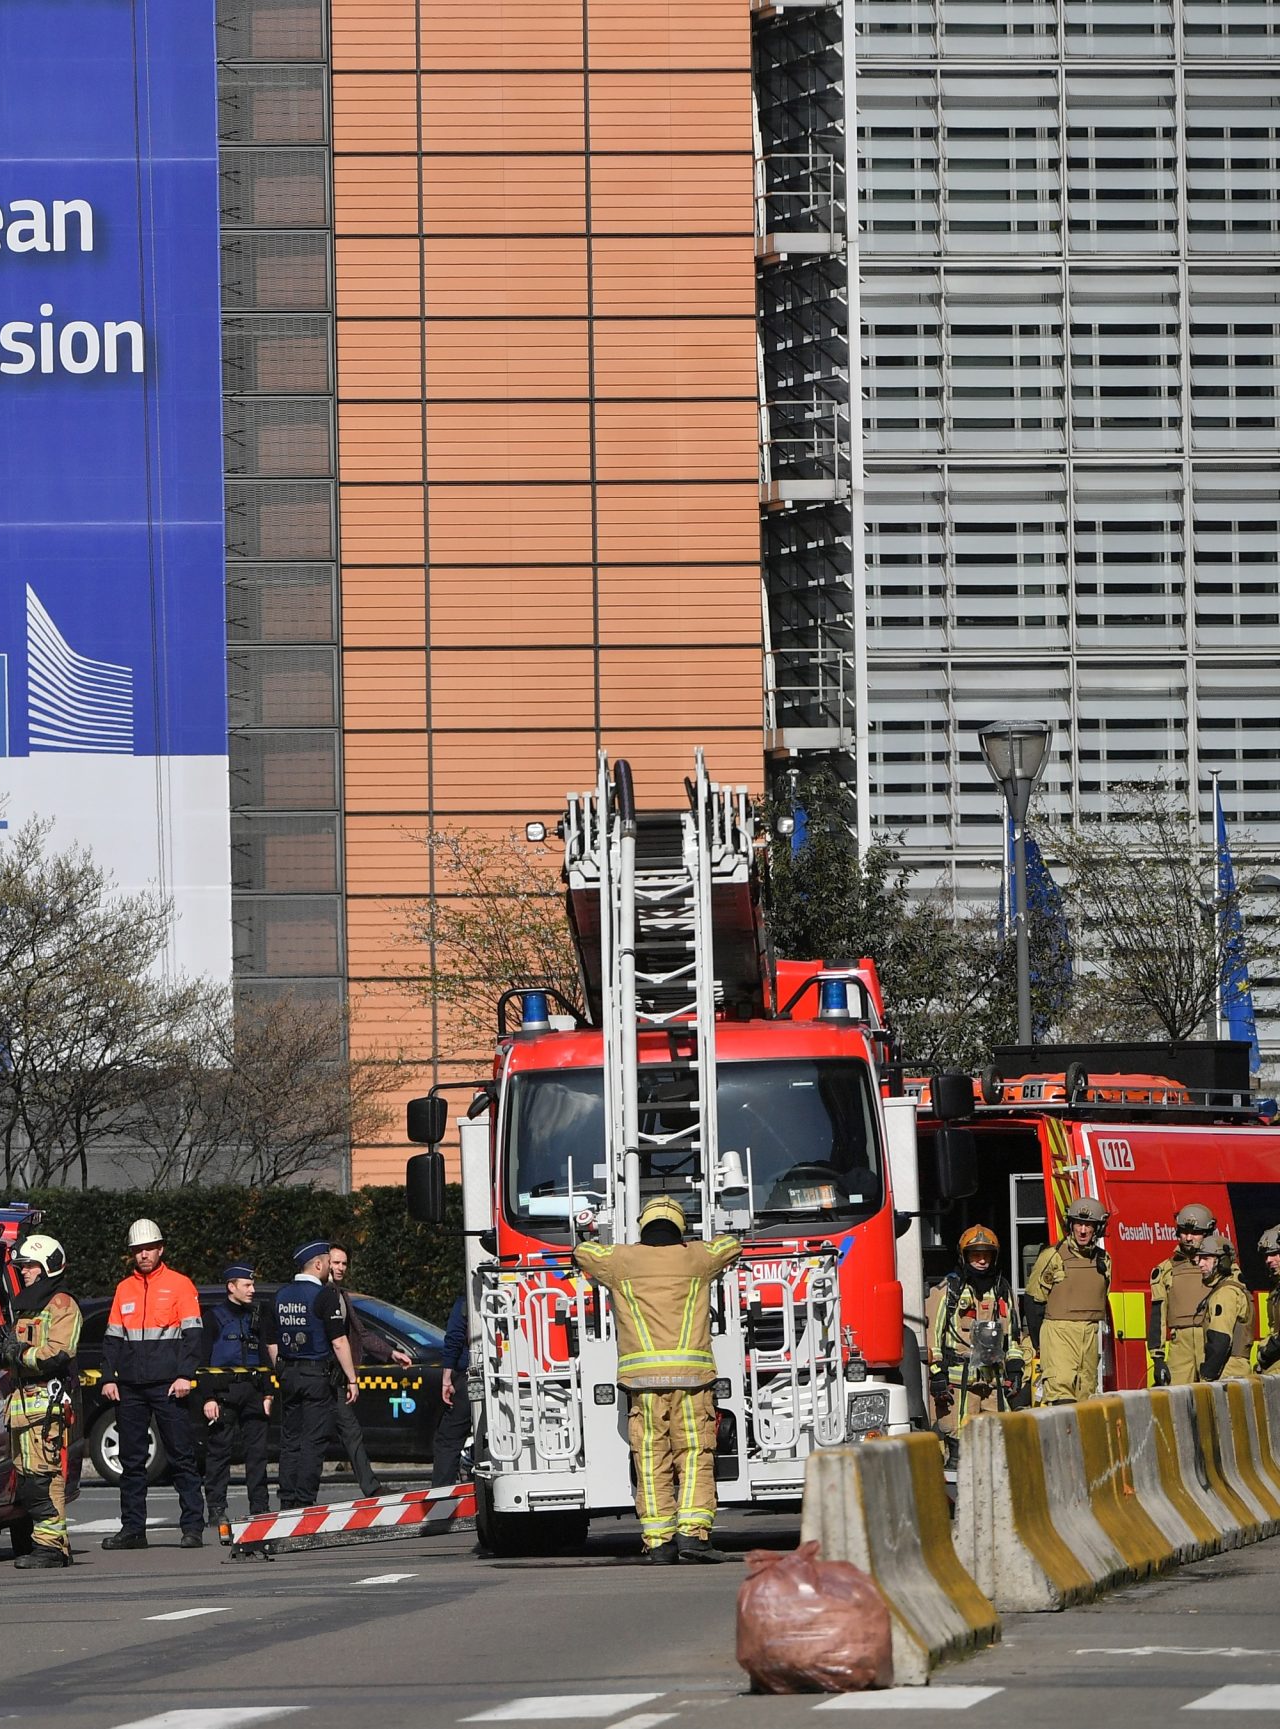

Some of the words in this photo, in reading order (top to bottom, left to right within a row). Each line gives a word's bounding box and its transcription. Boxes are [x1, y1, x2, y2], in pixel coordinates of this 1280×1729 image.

[1022, 1084, 1043, 1099] CET
[1107, 1141, 1132, 1169] 112
[1118, 1221, 1153, 1245] Casualty
[1154, 1222, 1179, 1241] Extra
[30, 1242, 43, 1252] 10
[278, 1303, 307, 1314] Politie
[279, 1315, 307, 1326] Police
